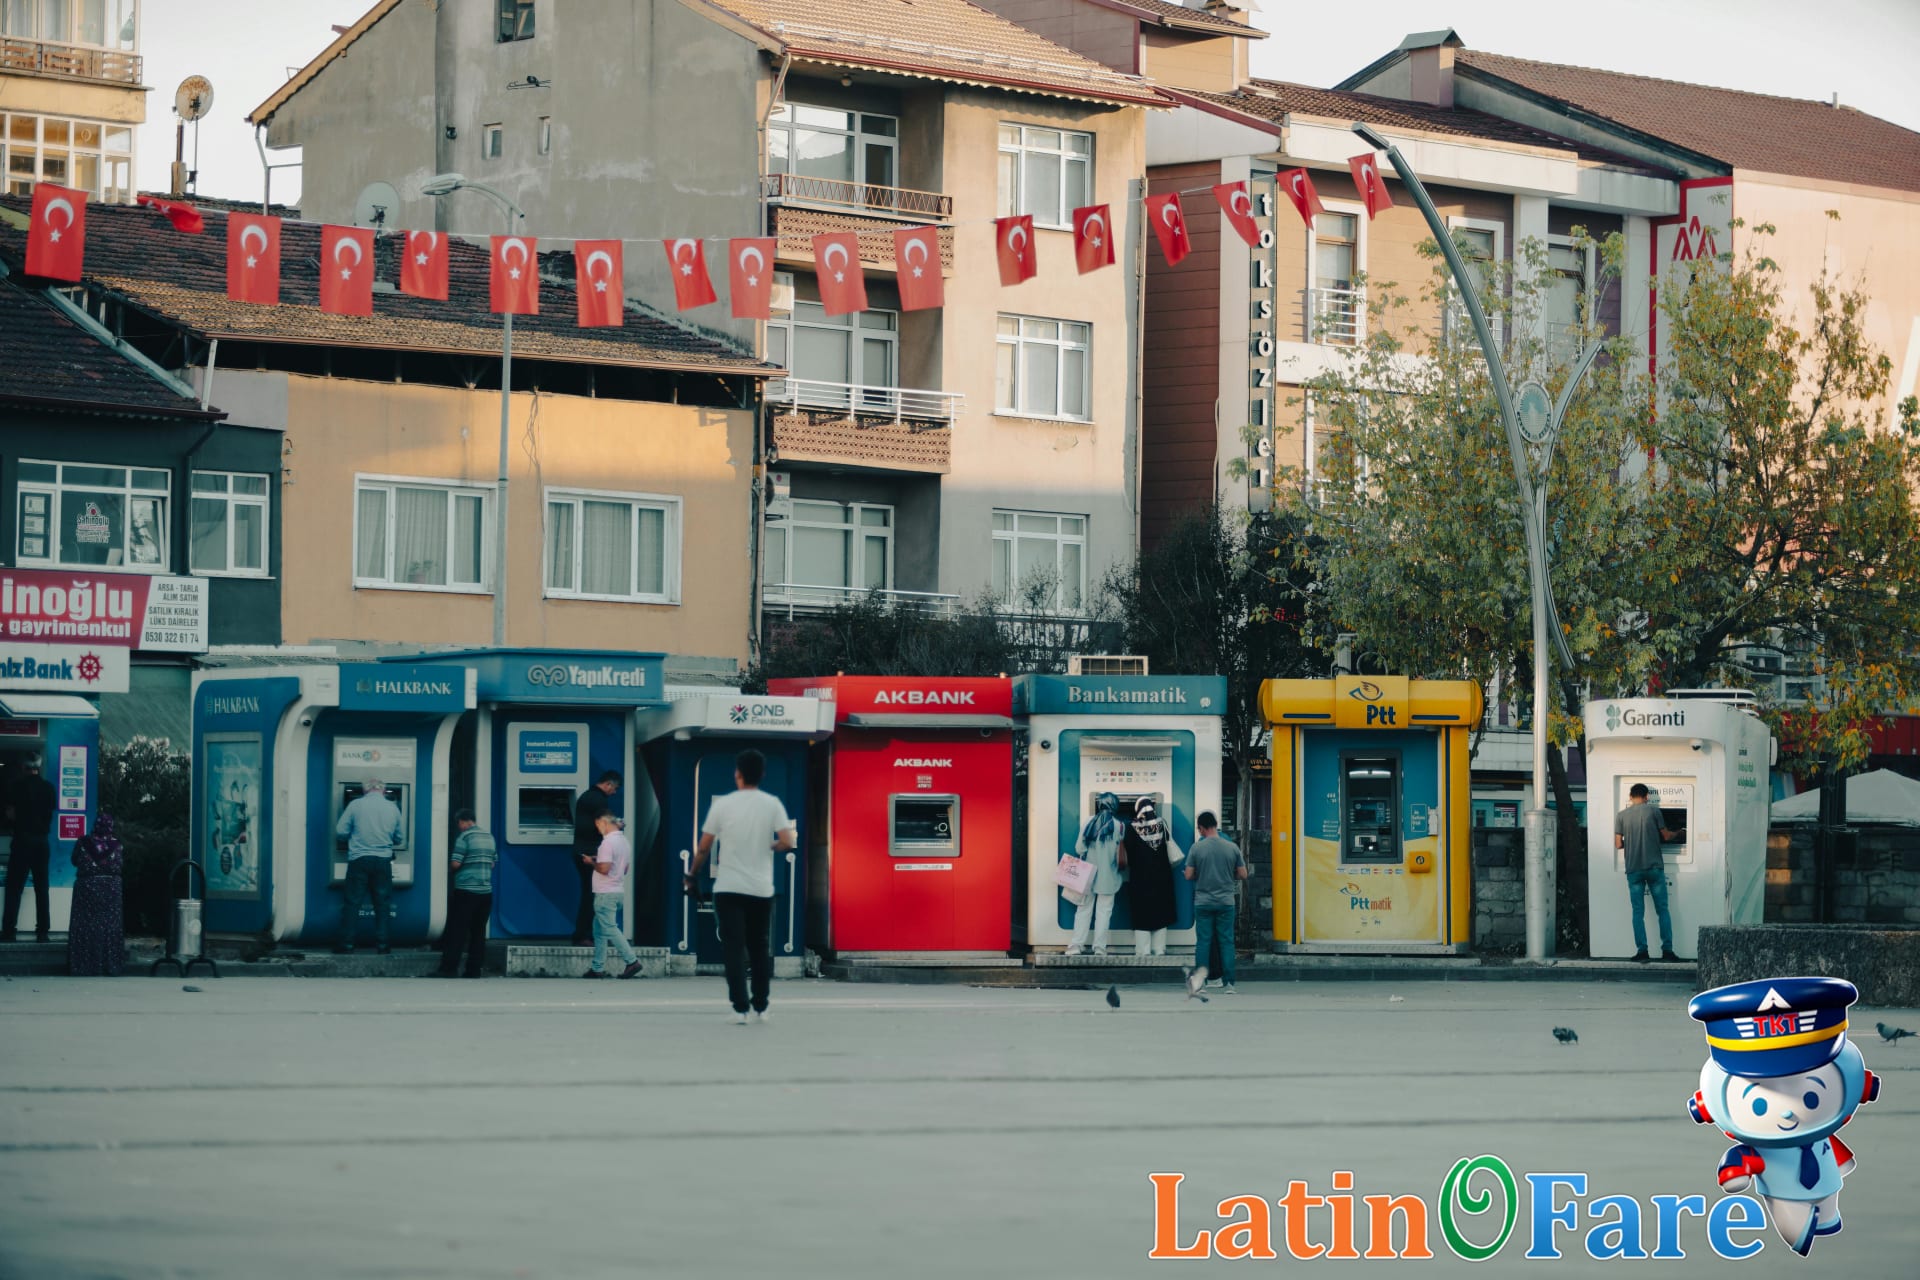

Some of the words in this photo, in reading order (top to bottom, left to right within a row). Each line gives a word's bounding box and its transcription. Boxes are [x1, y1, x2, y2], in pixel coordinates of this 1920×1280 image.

[1258, 192, 1274, 488] toksözler
[157, 583, 174, 591] ARSA
[179, 584, 199, 593] TARLA
[163, 592, 178, 601] ALIM
[179, 594, 199, 602] SATIM
[148, 606, 172, 615] SATILIK
[174, 607, 199, 616] KIRALIK
[149, 616, 166, 625] LÜKS
[9, 619, 131, 638] gayrimenkul
[145, 631, 163, 642] 0530
[165, 632, 178, 643] 322
[190, 633, 199, 644] 74
[568, 664, 645, 689] YapıKredi
[375, 681, 453, 696] HALKBANK
[1068, 685, 1187, 704] Bankamatik
[214, 696, 260, 714] HALKBANK
[874, 690, 976, 705] AKBANK
[751, 703, 784, 716] QNB
[1366, 704, 1396, 725] Ptt
[1623, 709, 1685, 726] Garanti
[893, 758, 953, 768] AKBANK
